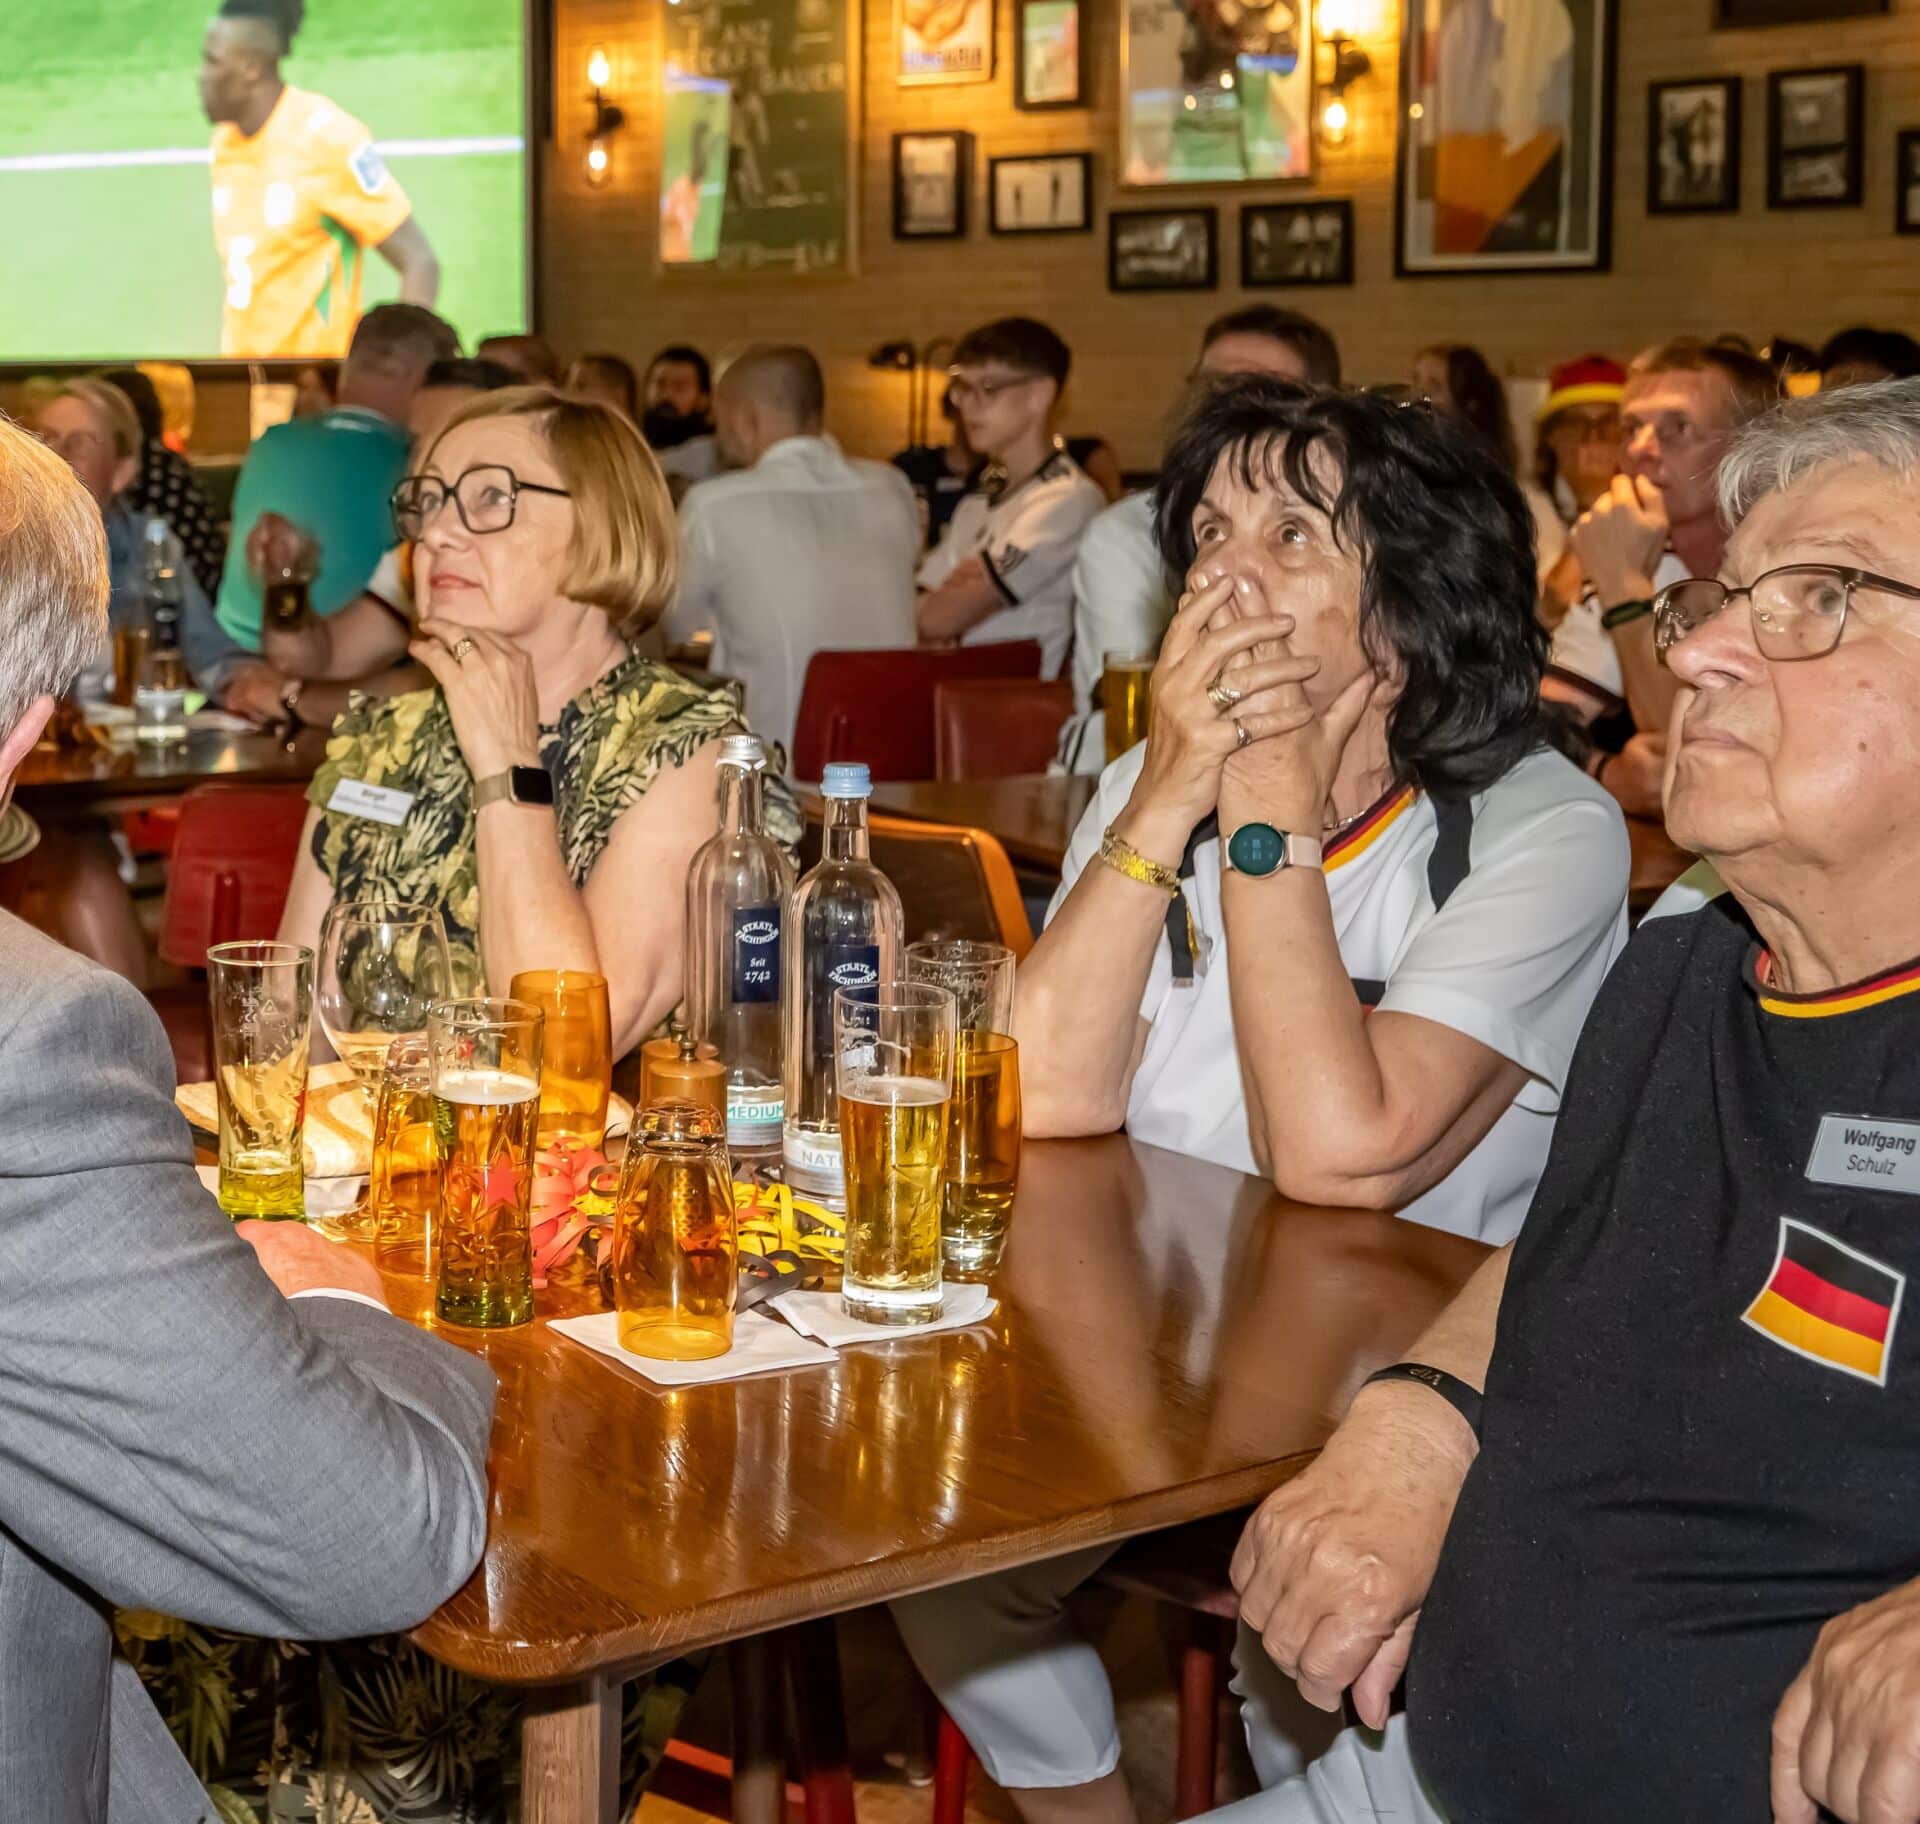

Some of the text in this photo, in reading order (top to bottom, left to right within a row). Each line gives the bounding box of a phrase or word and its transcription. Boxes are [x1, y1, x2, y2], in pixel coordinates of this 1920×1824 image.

[1844, 1127, 1917, 1156] Wolfgang
[802, 1150, 842, 1168] NAT
[1846, 1153, 1897, 1176] Schulz
